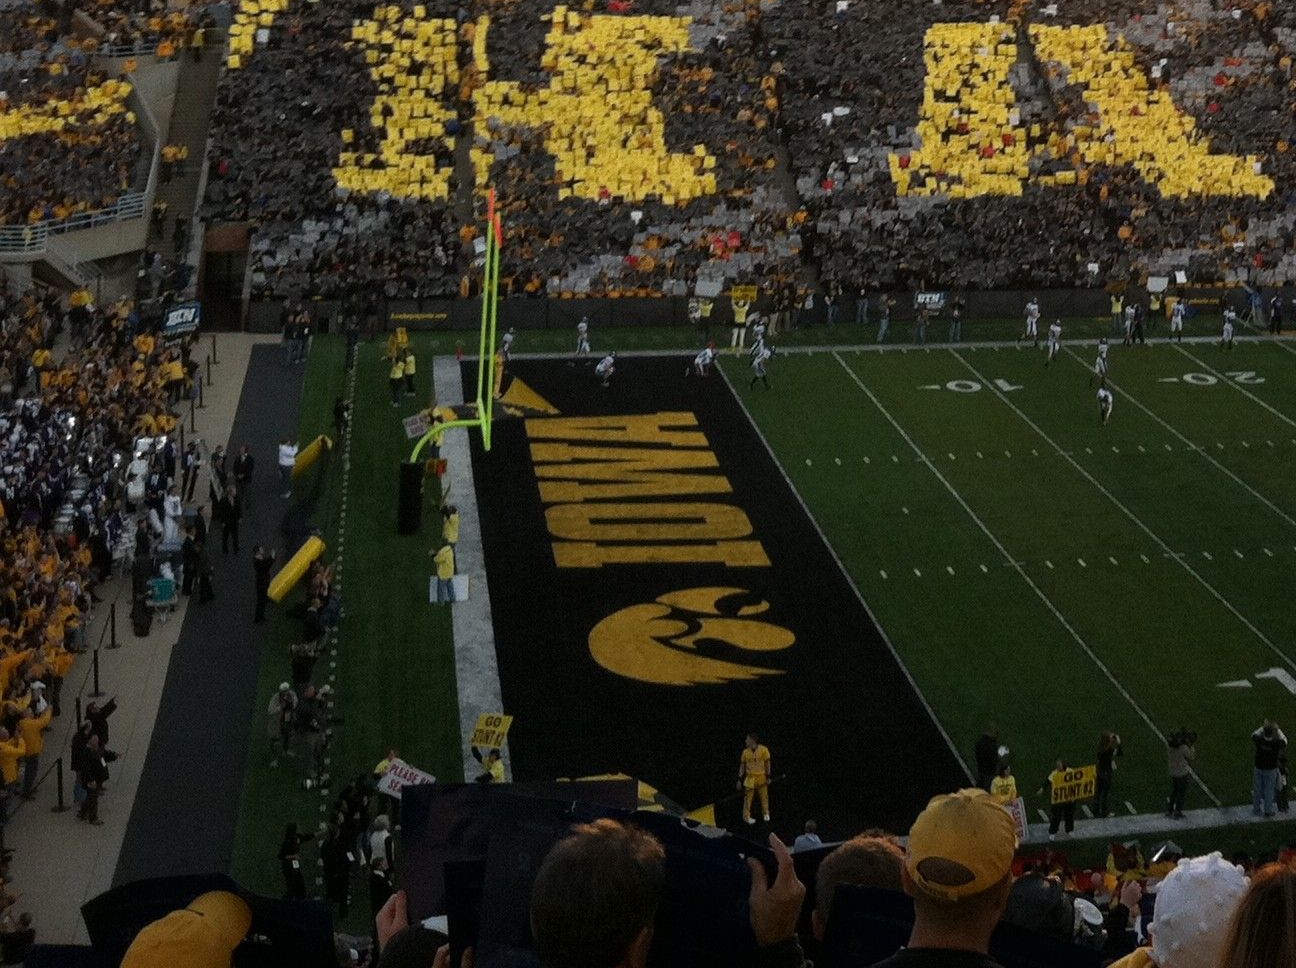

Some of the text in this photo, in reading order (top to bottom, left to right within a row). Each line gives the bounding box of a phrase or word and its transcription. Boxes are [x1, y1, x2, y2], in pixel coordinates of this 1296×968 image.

[524, 410, 773, 568] IOWA
[485, 716, 503, 727] GO
[390, 763, 419, 782] PLEASE
[1063, 770, 1084, 783] GO
[1053, 783, 1081, 801] STUNT
